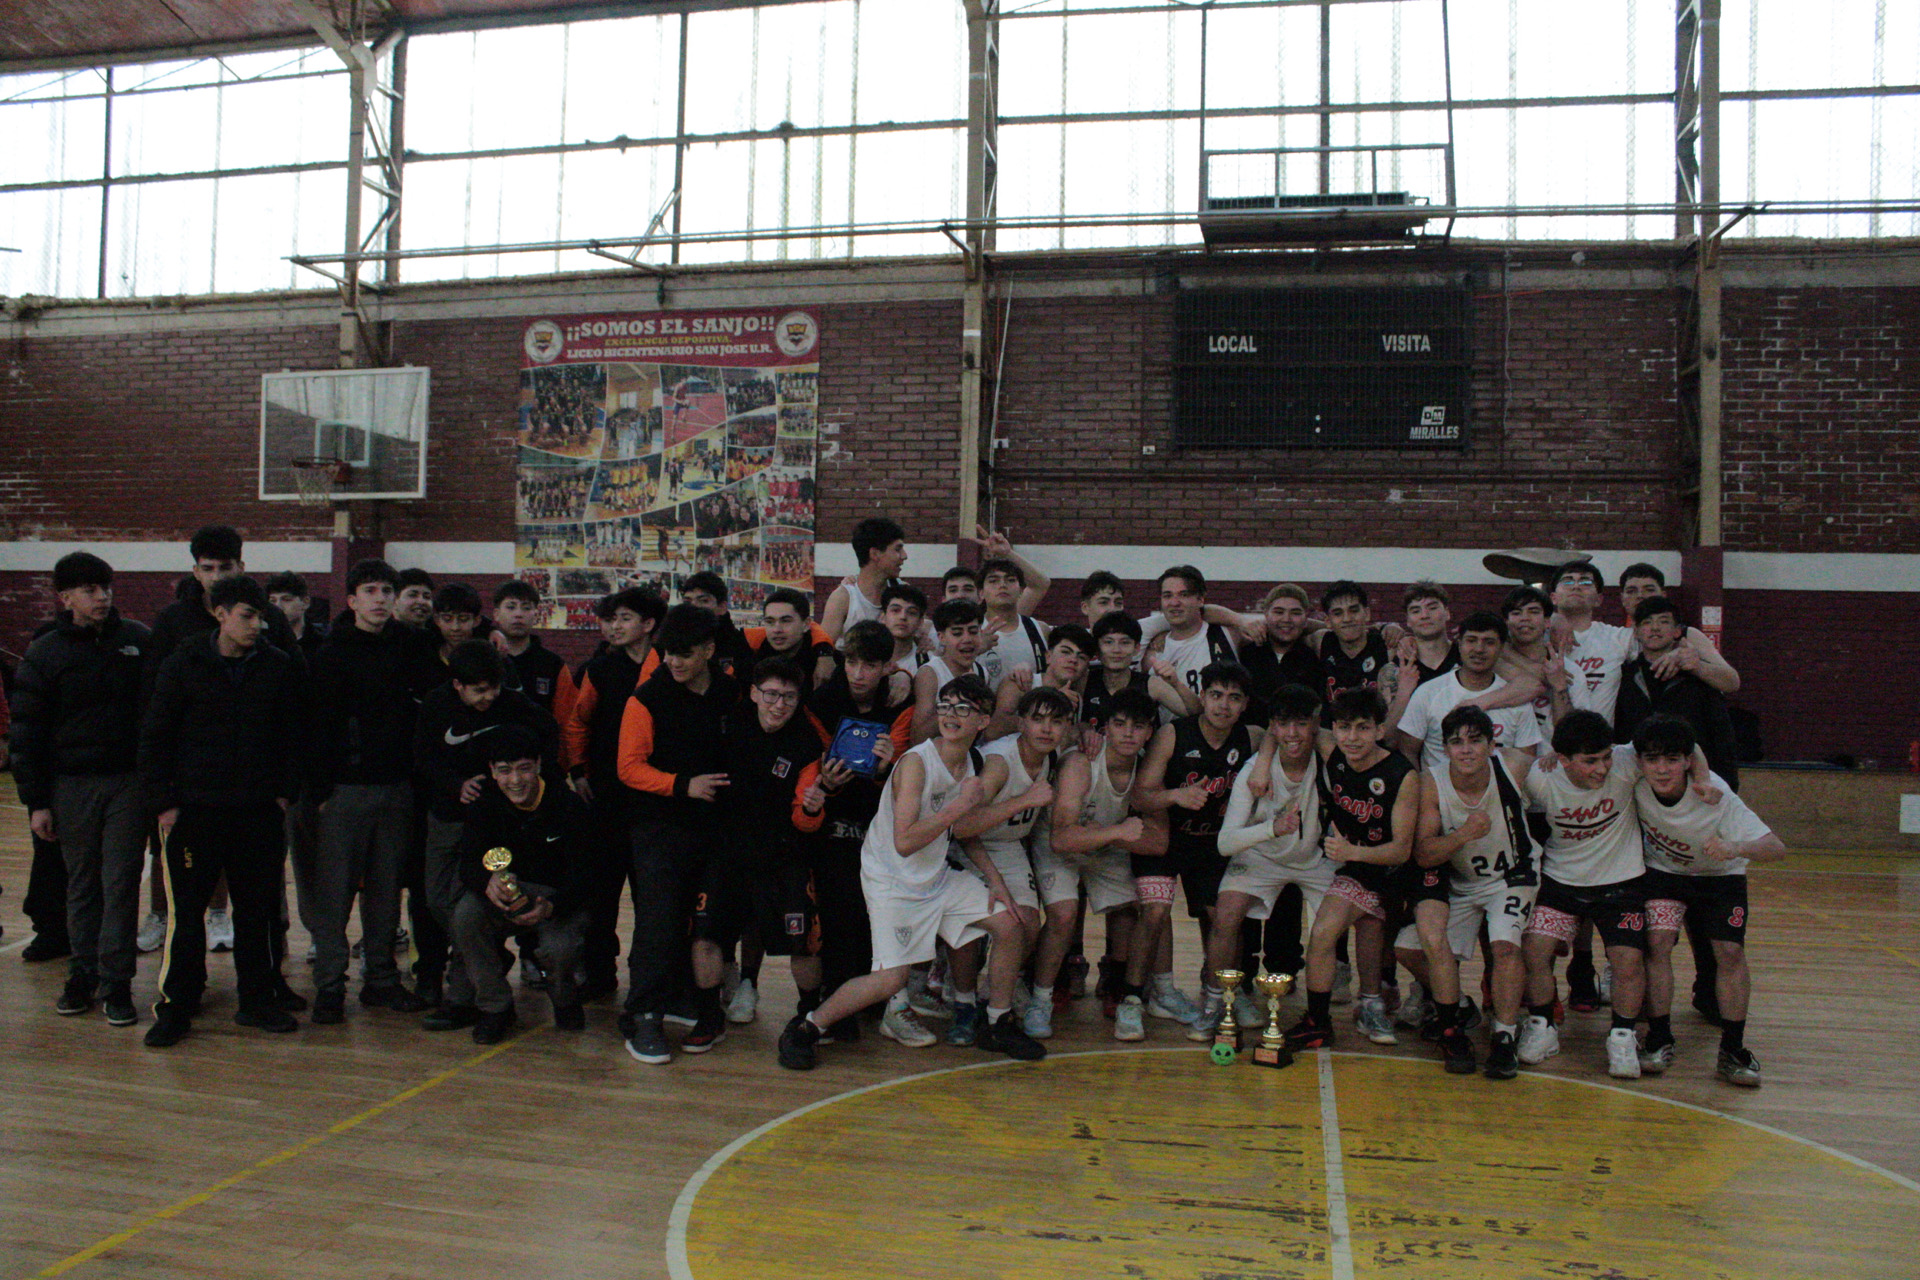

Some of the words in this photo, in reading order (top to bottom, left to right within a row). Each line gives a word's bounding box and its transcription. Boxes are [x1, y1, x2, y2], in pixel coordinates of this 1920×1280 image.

[660, 318, 688, 334] EL
[692, 316, 775, 336] SANJO!!
[605, 336, 668, 346] EXCELENCIA
[1208, 335, 1257, 353] LOCAL
[1382, 334, 1431, 352] VISITA
[567, 348, 602, 359] LICEO
[604, 345, 693, 357] BICENTENARIO
[695, 344, 719, 355] SAN
[719, 344, 748, 357] JOSE
[749, 343, 773, 354] U.R.
[1409, 425, 1460, 439] MIRALLES
[1332, 784, 1383, 823] Sanjo
[1471, 850, 1510, 878] 24
[696, 892, 708, 911] 3
[1504, 895, 1532, 921] 24
[1728, 906, 1744, 927] 8
